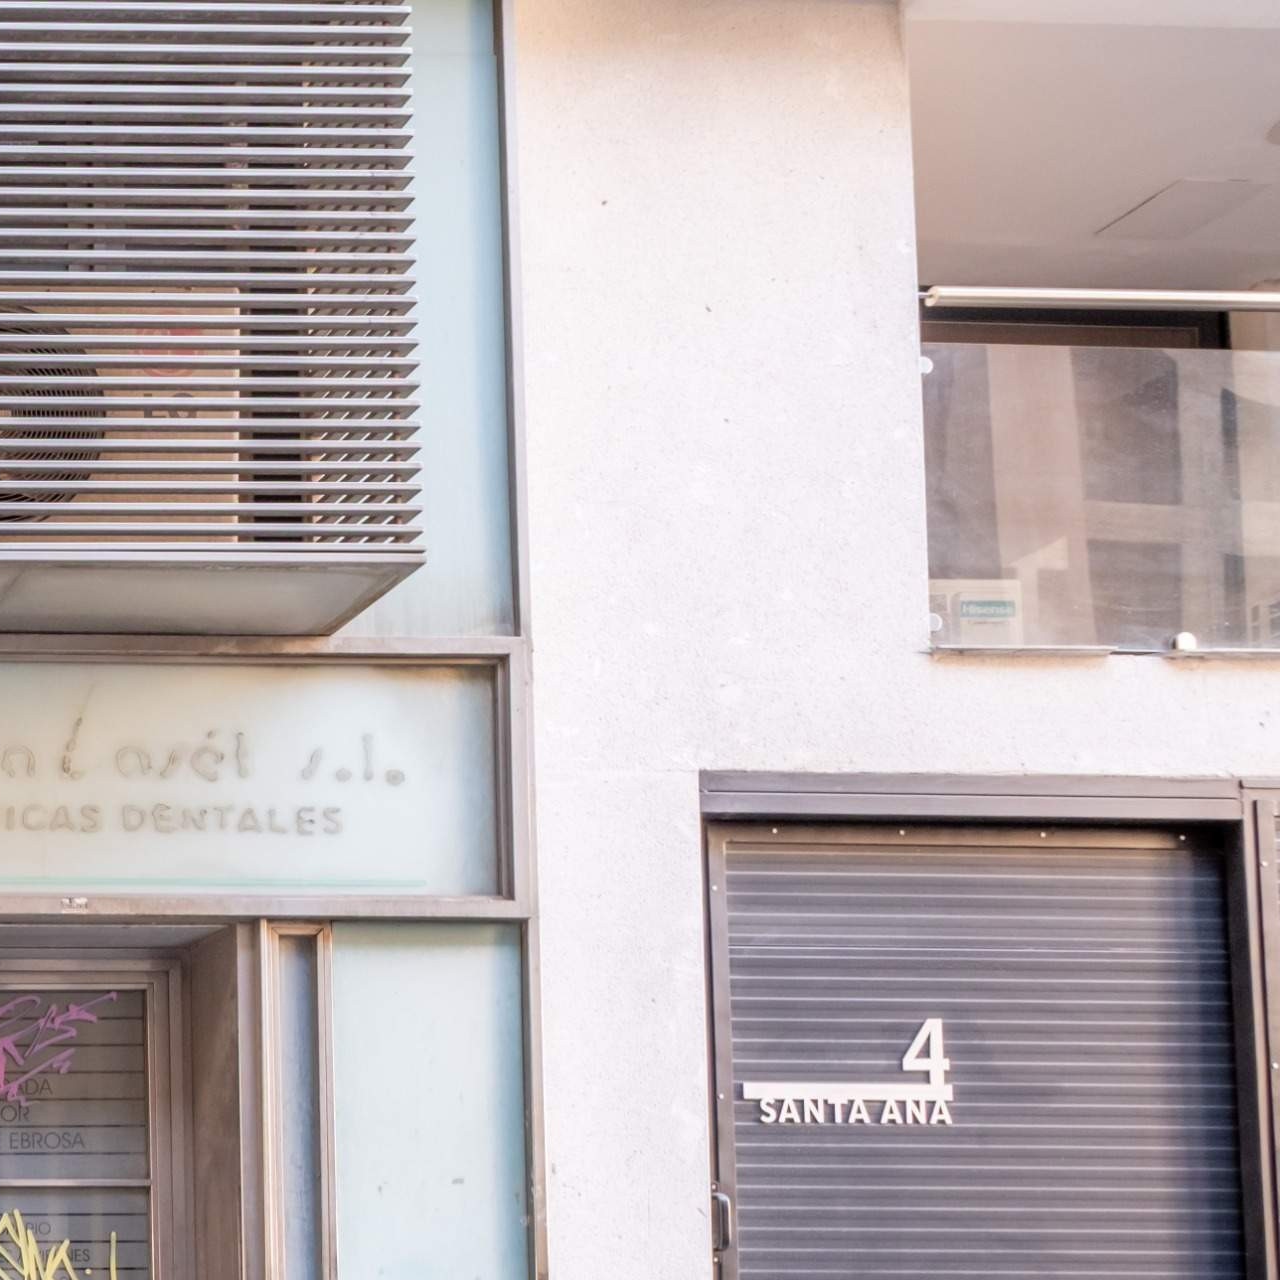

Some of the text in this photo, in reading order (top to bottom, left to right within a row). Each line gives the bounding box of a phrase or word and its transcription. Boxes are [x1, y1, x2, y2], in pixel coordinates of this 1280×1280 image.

[121, 804, 344, 836] DENTALES
[901, 1017, 951, 1087] 4
[759, 1098, 953, 1125] SANTA ANA
[9, 1132, 86, 1150] EBROSA
